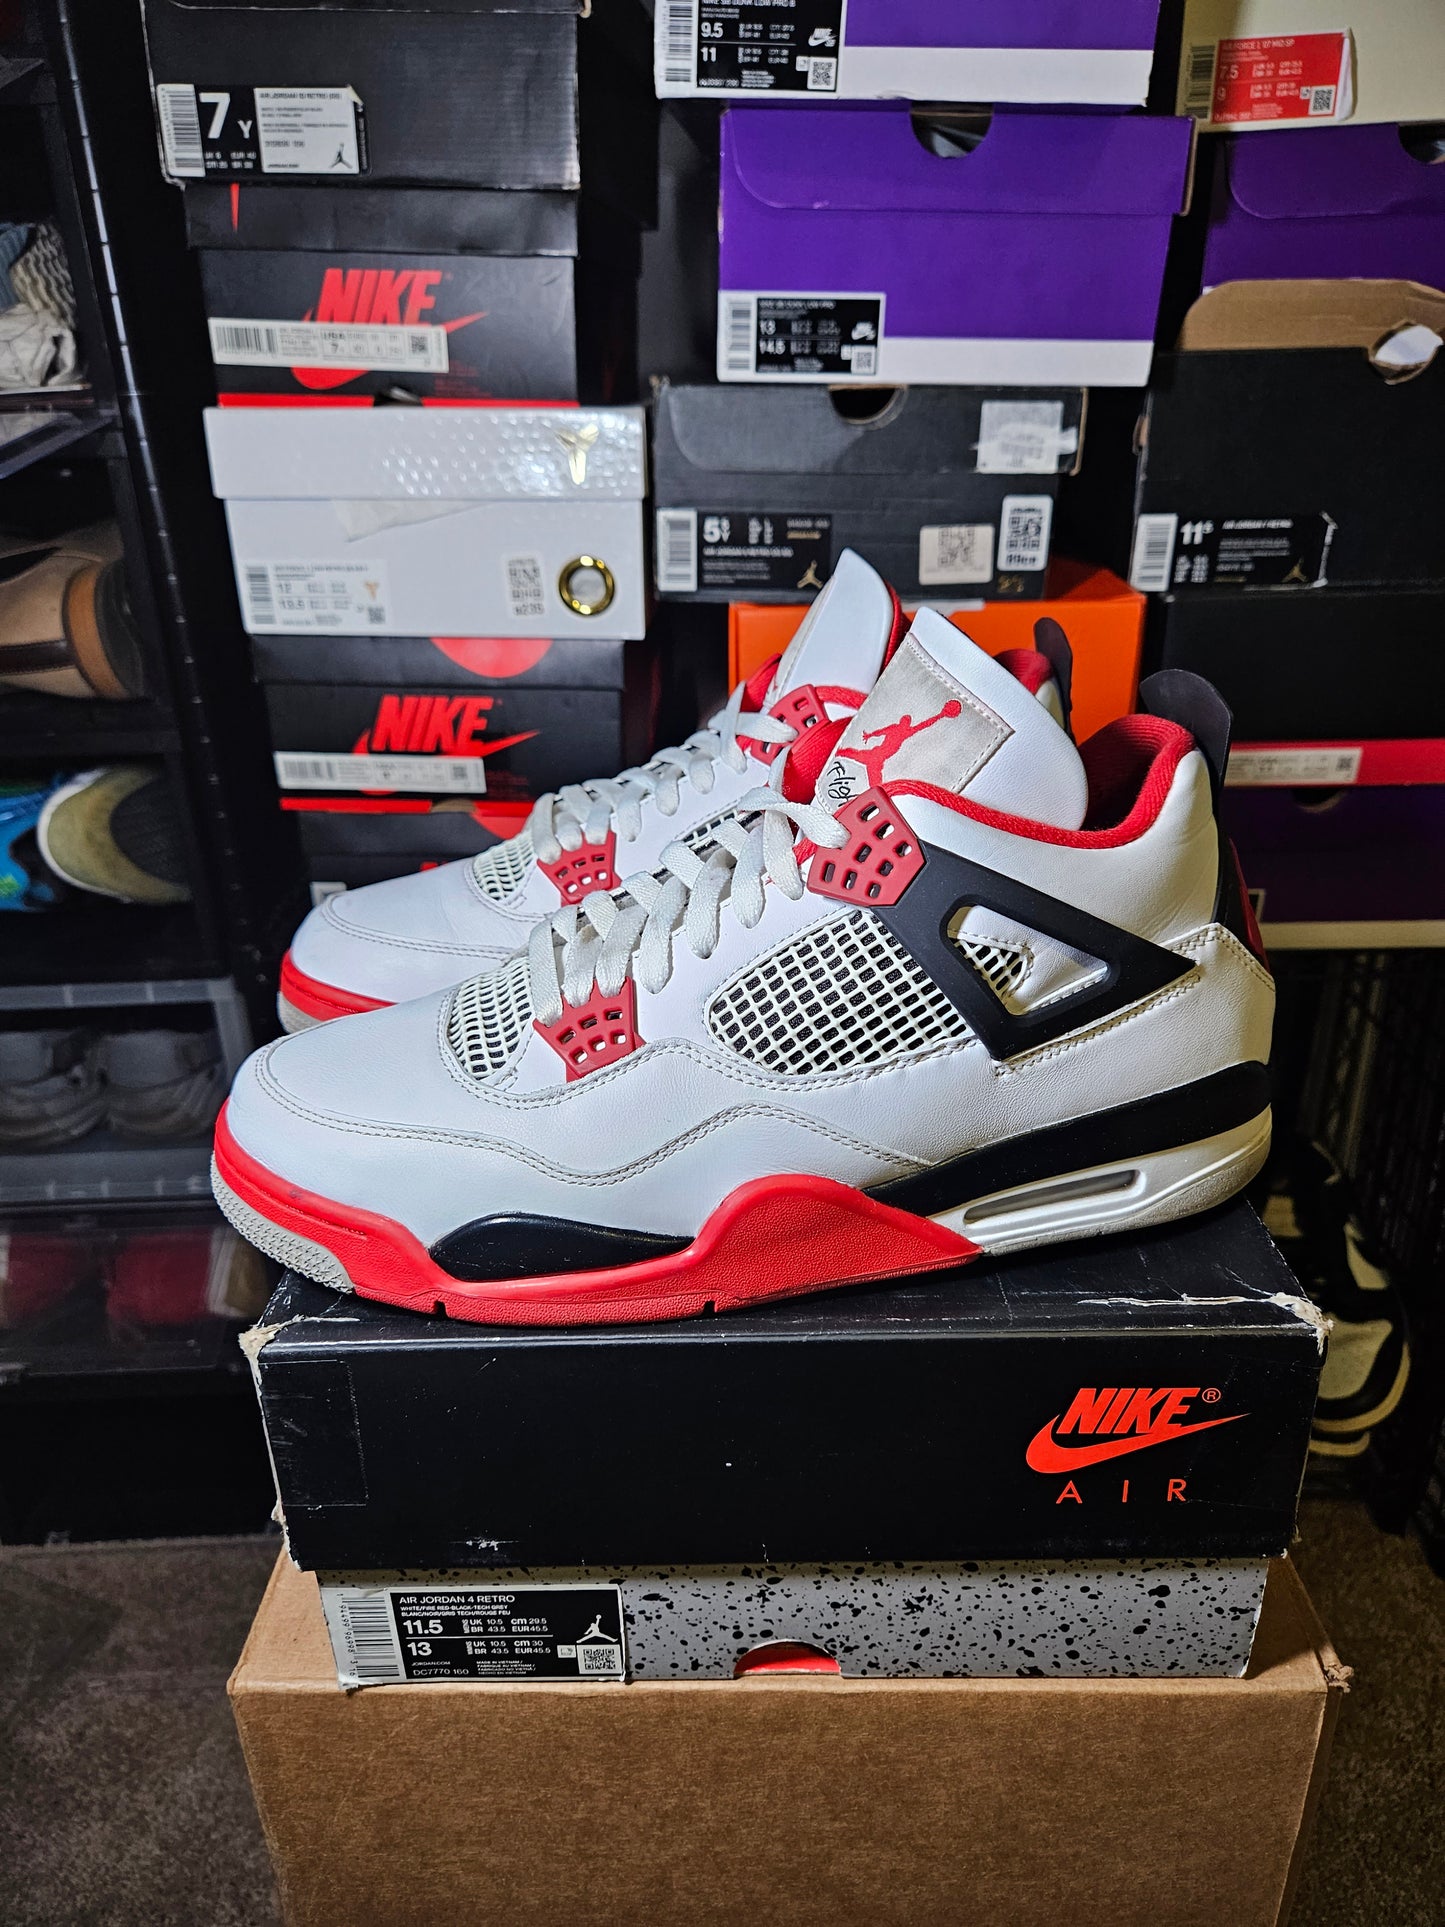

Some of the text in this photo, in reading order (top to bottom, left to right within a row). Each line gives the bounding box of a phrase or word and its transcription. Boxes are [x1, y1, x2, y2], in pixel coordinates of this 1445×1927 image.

[700, 22, 724, 39] 9.5
[700, 47, 717, 62] 11
[199, 93, 252, 139] 7 Y
[315, 268, 443, 327] NIKE
[371, 695, 495, 752] NIKE
[1056, 1387, 1201, 1434] NIKE
[1055, 1478, 1188, 1504] AIR
[399, 1594, 516, 1604] AIR JORDAN 4 RETRO
[403, 1619, 444, 1635] 11.5
[528, 1617, 547, 1625] 29.5
[487, 1625, 506, 1633] 43.5
[407, 1641, 432, 1656] 13
[490, 1647, 510, 1655] 43.5
[413, 1668, 451, 1676] DC7770
